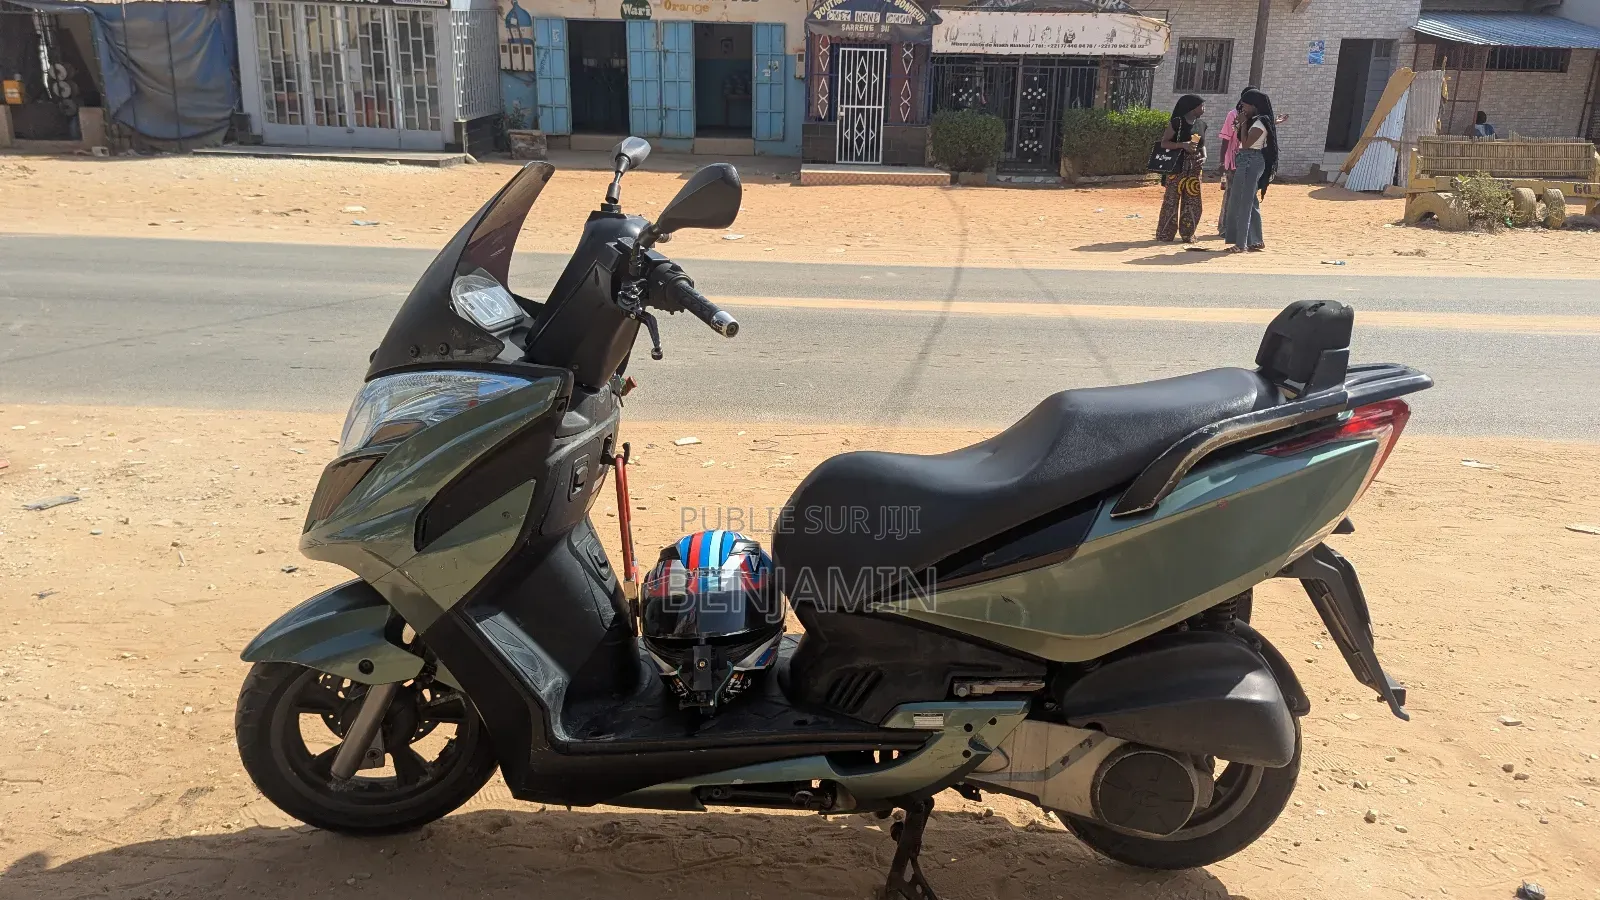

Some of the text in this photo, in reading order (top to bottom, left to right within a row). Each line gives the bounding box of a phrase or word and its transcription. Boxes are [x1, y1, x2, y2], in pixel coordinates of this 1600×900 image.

[621, 3, 652, 16] Wari
[664, 0, 710, 14] Orange
[813, 0, 926, 25] BOUTIQ BONHEUR
